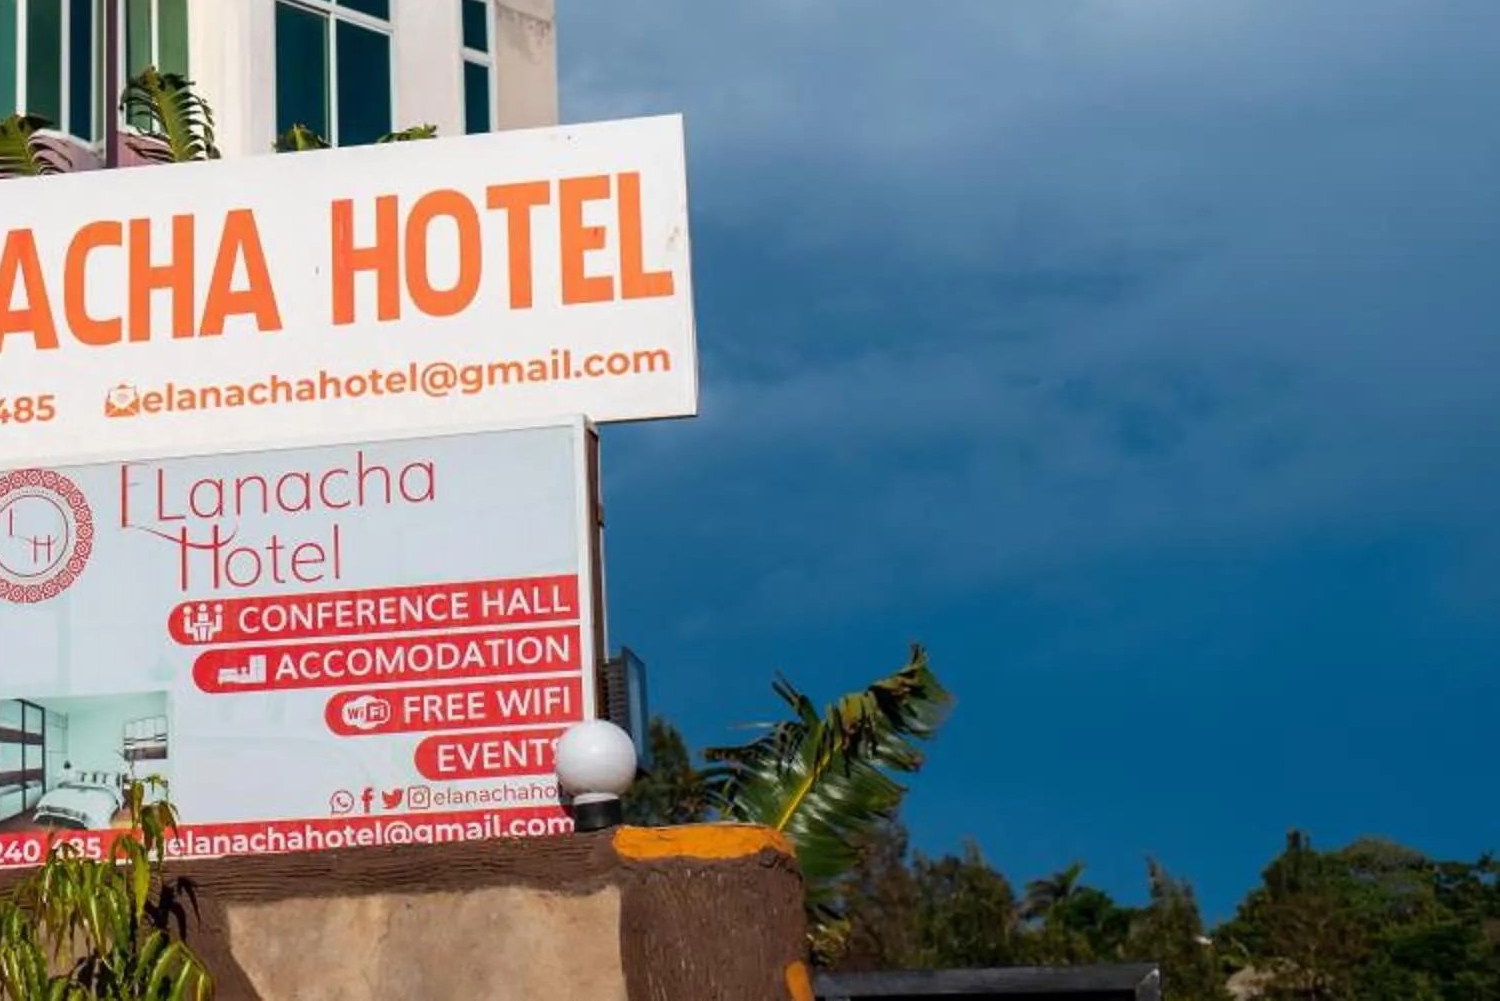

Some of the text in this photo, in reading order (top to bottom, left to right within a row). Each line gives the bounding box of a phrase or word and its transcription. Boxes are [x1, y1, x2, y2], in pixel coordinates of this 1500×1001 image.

[331, 171, 674, 326] HOTEL
[142, 345, 671, 415] elanachahotel@gmail.com
[180, 524, 341, 591] Hotel
[238, 585, 571, 634] CONFERENCE HALL
[275, 635, 570, 681] ACCOMODATION
[403, 686, 570, 724] FREE WIFI
[434, 782, 558, 806] elanachaho
